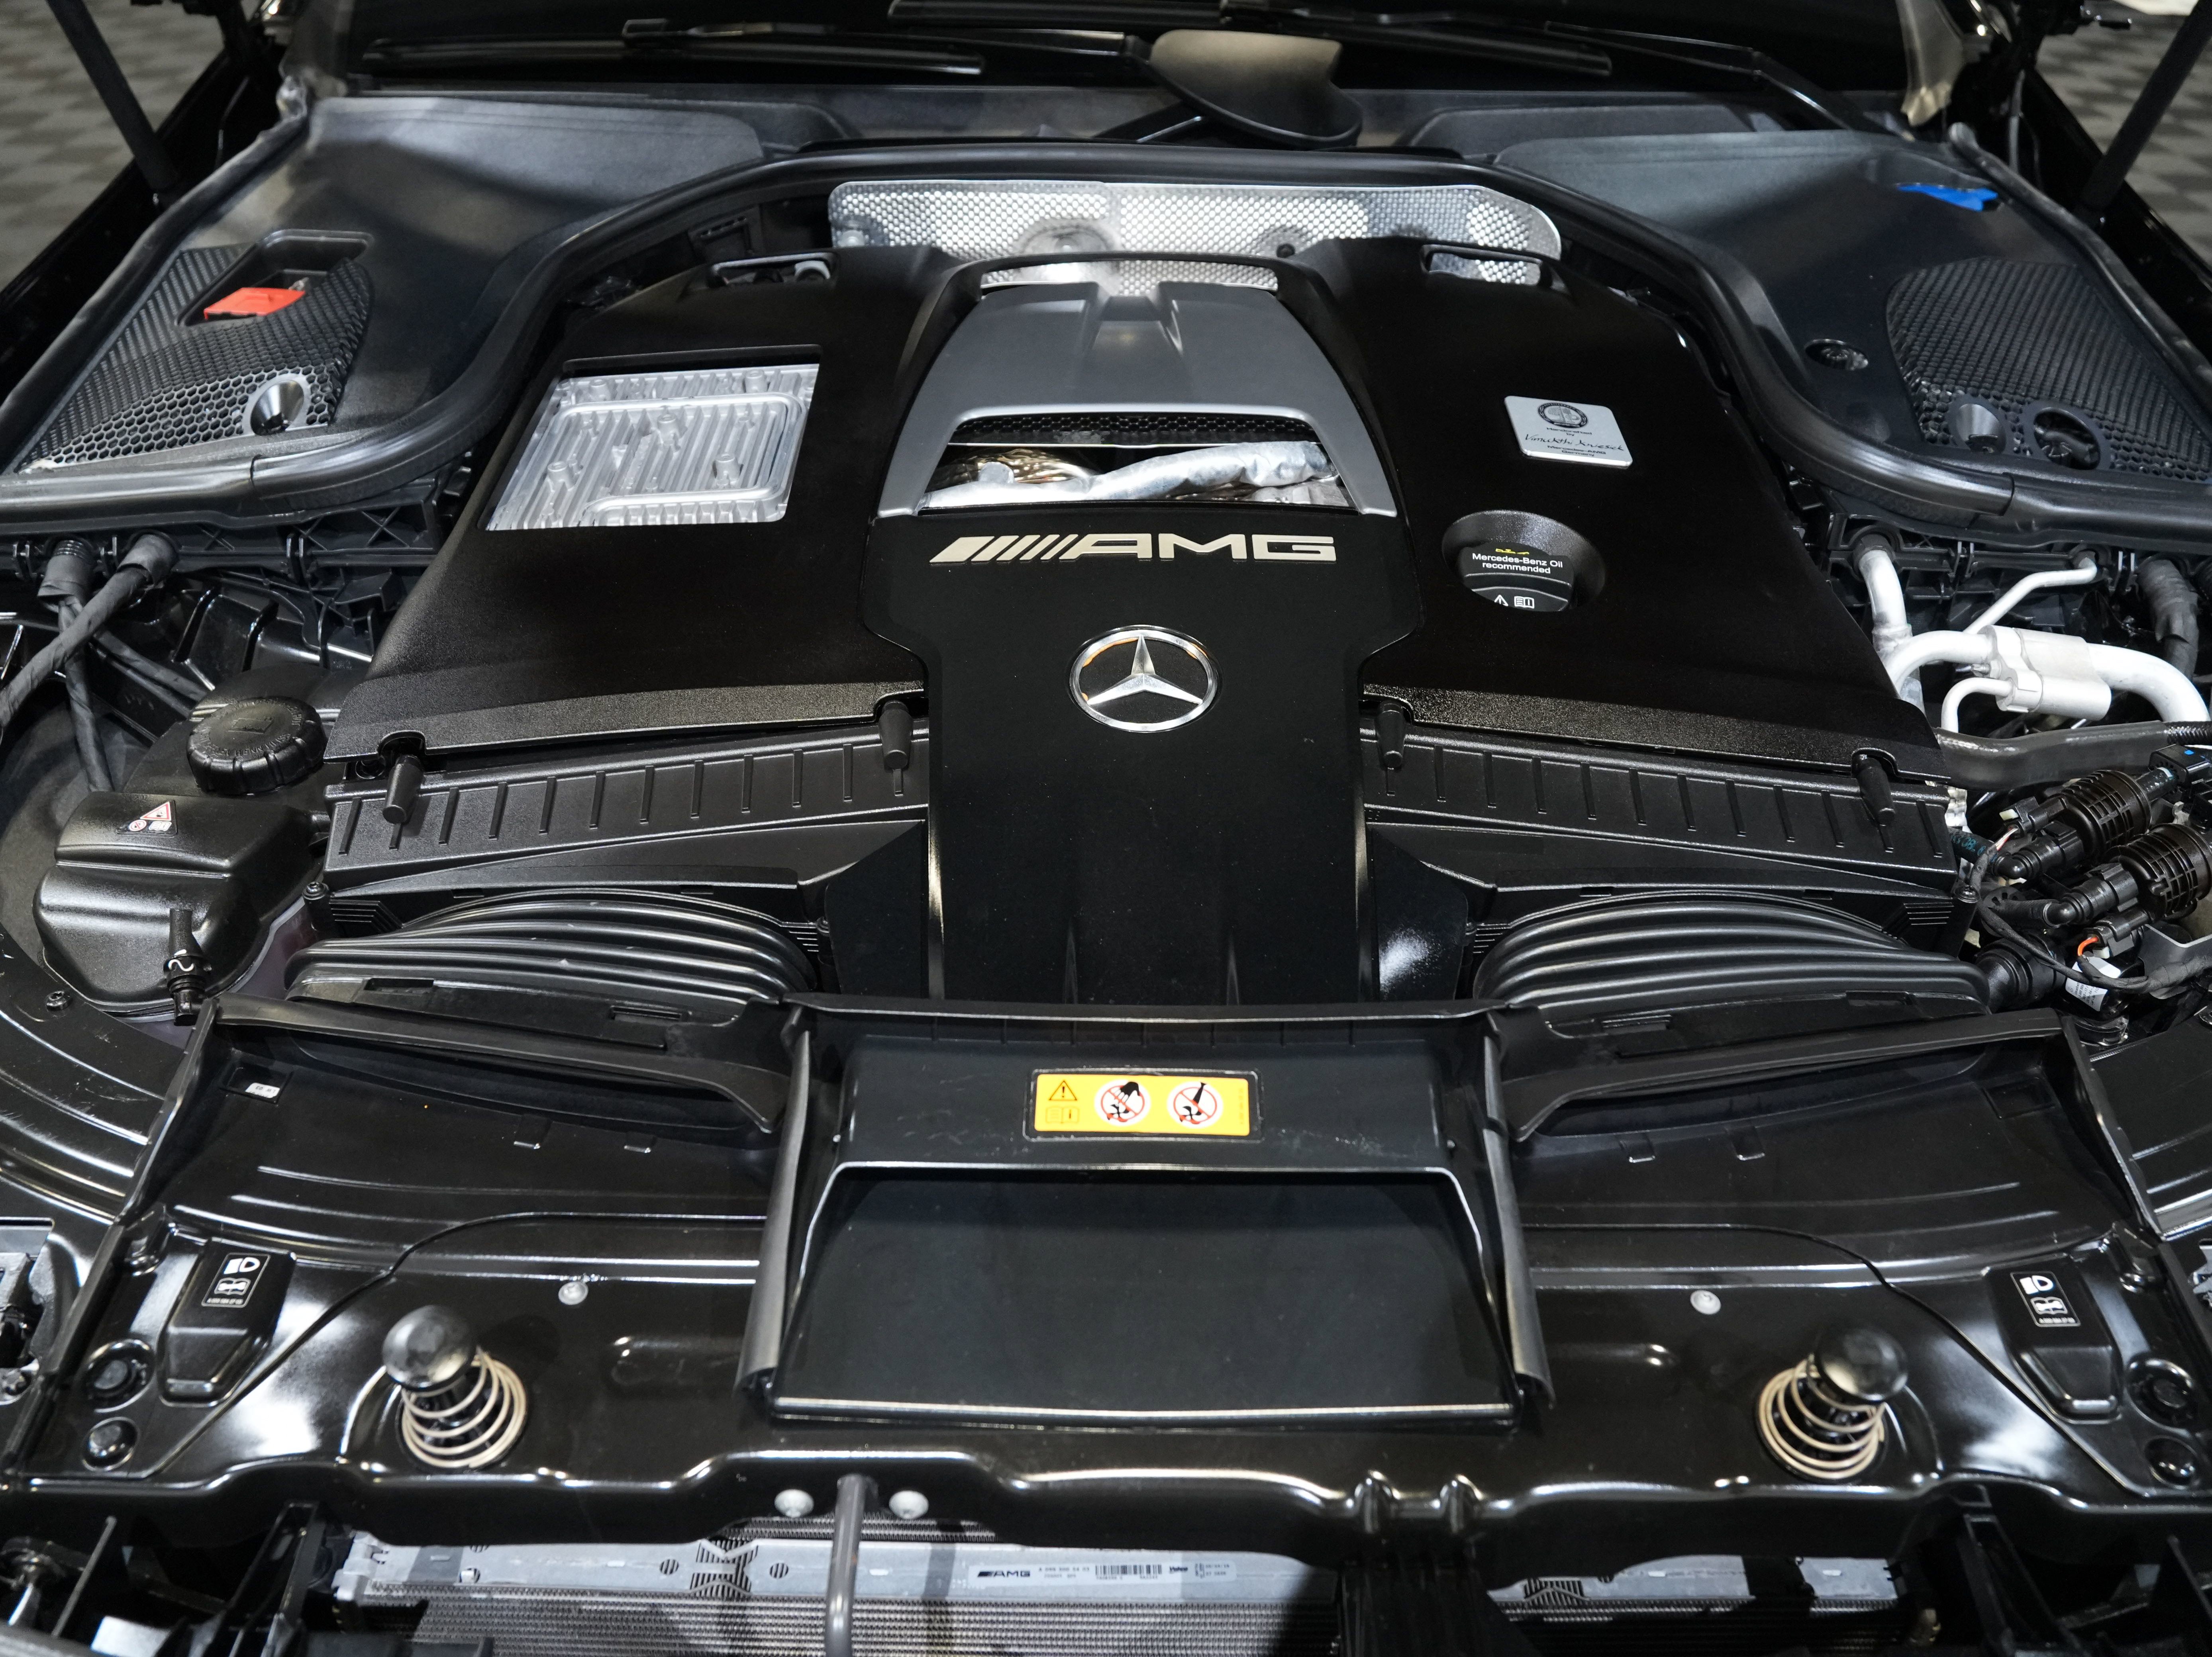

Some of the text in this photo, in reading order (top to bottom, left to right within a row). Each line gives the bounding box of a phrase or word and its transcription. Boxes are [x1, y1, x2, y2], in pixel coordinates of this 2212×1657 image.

[1547, 445, 1606, 454] Mercedes-AMG
[1059, 533, 1337, 562] AMG
[1472, 553, 1547, 566] Mercedes-Benz
[1482, 562, 1551, 574] recommended
